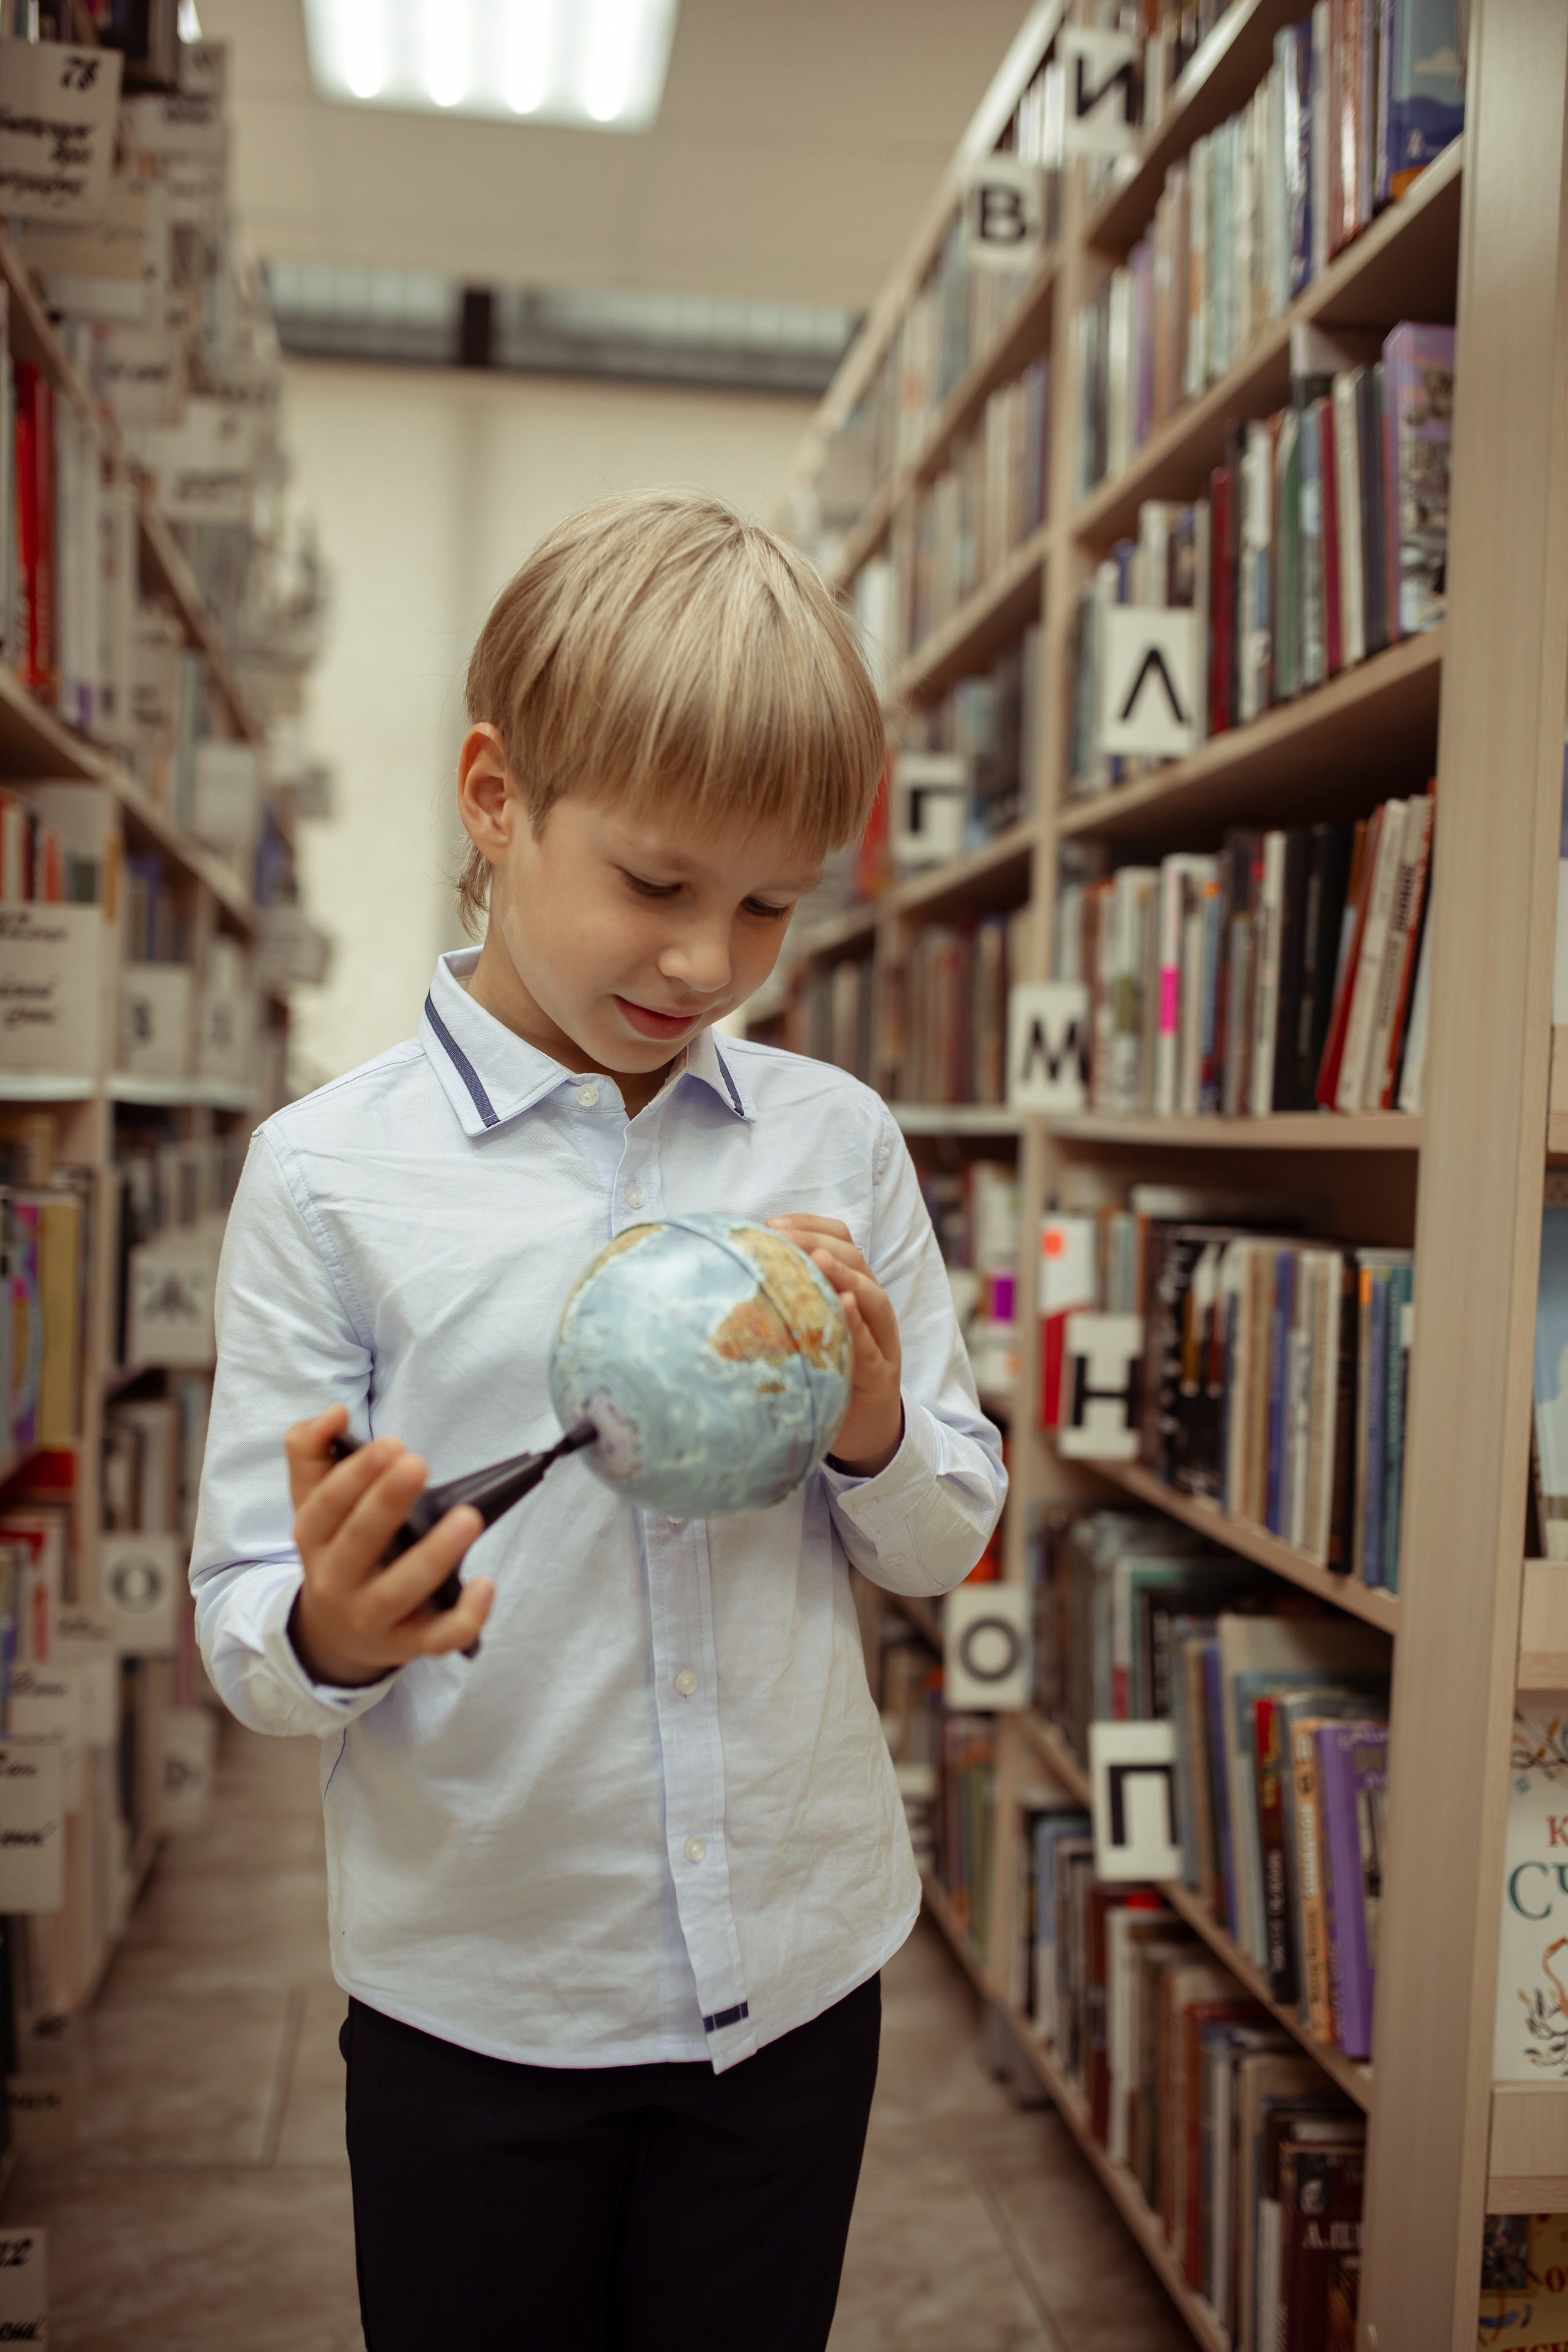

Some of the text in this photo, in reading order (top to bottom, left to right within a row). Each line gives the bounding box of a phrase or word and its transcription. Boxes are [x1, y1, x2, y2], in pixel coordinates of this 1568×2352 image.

[1076, 53, 1140, 124] И
[980, 186, 1027, 243] В
[1022, 1019, 1088, 1084] М
[1072, 1352, 1137, 1428] Н
[959, 1617, 1020, 1683] О
[1109, 1764, 1180, 1847] П
